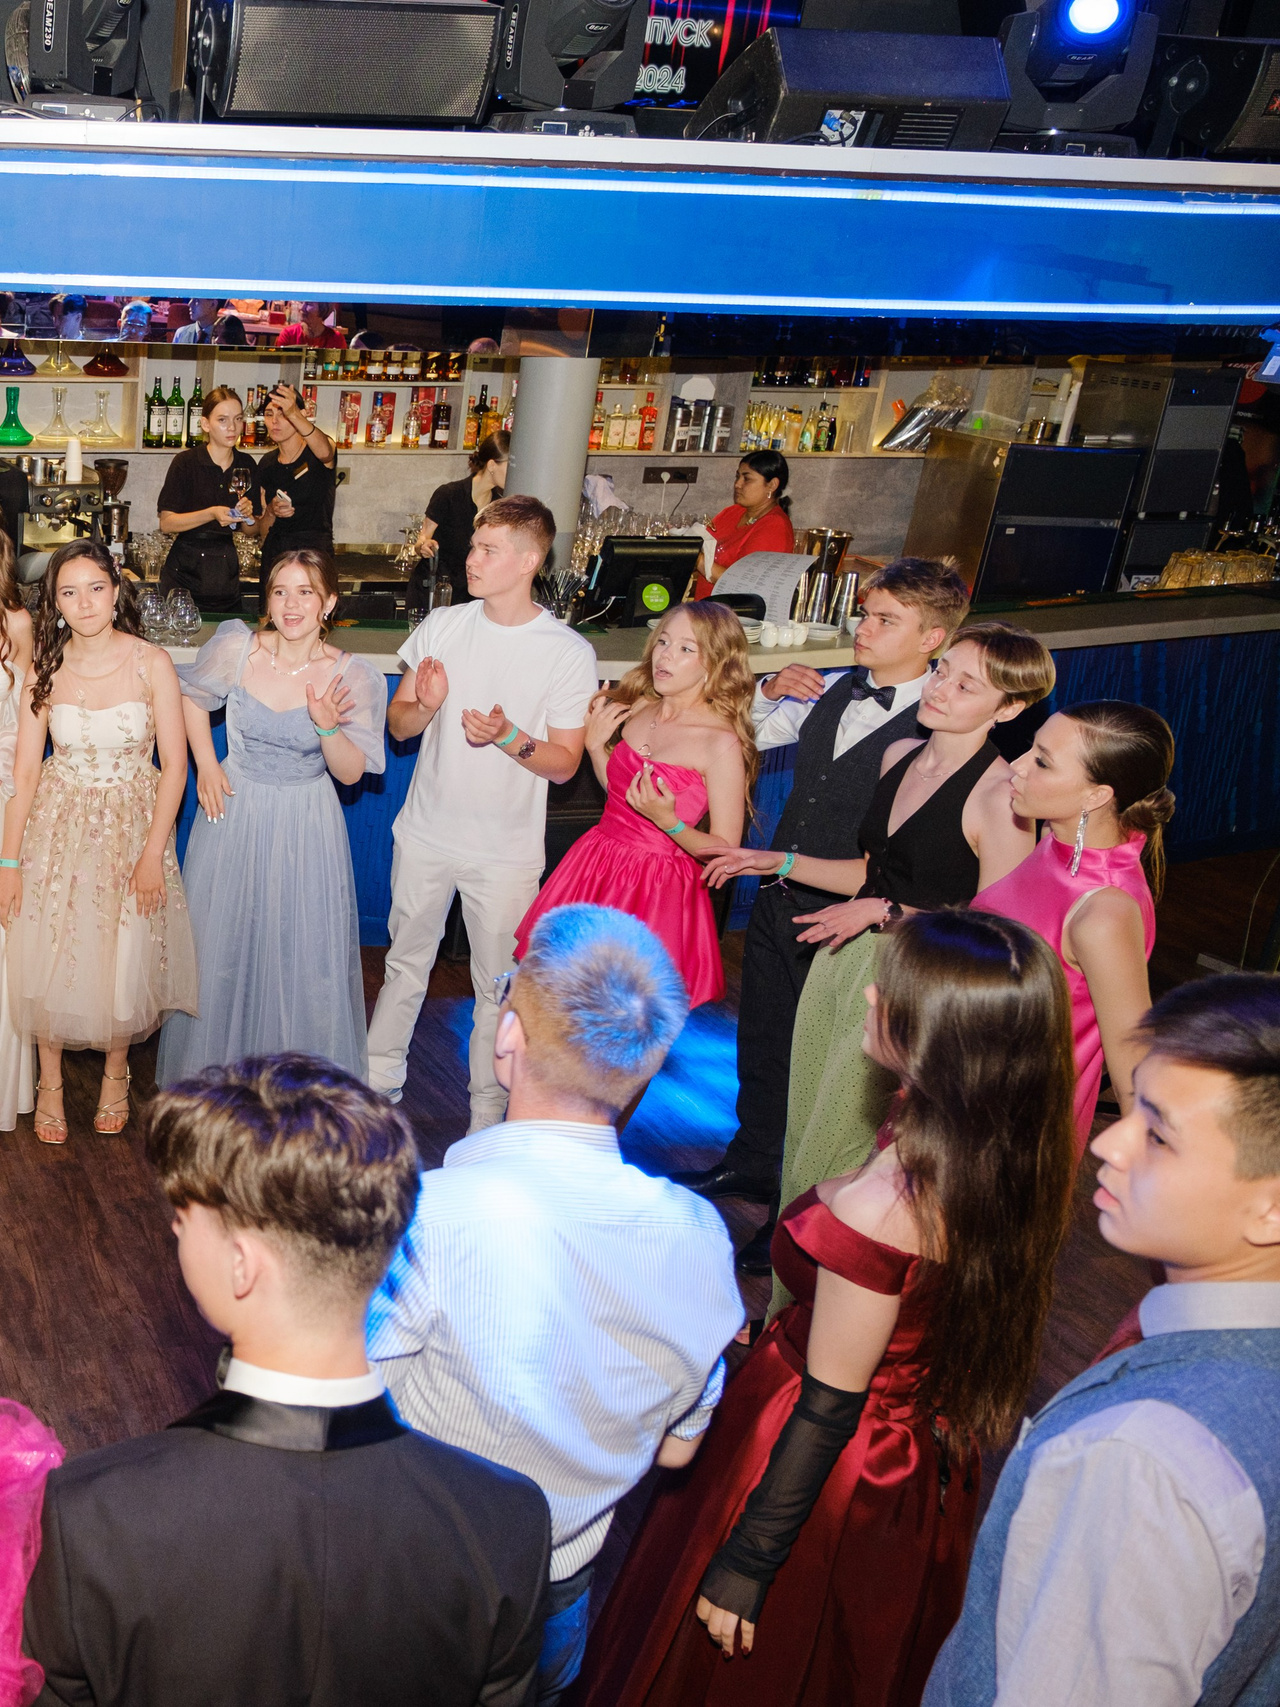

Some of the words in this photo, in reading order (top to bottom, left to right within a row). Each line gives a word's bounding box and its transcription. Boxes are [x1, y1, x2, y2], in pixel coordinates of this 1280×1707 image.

[506, 12, 517, 63] BEAM230
[645, 16, 714, 47] ПУСК
[635, 64, 686, 94] 2024
